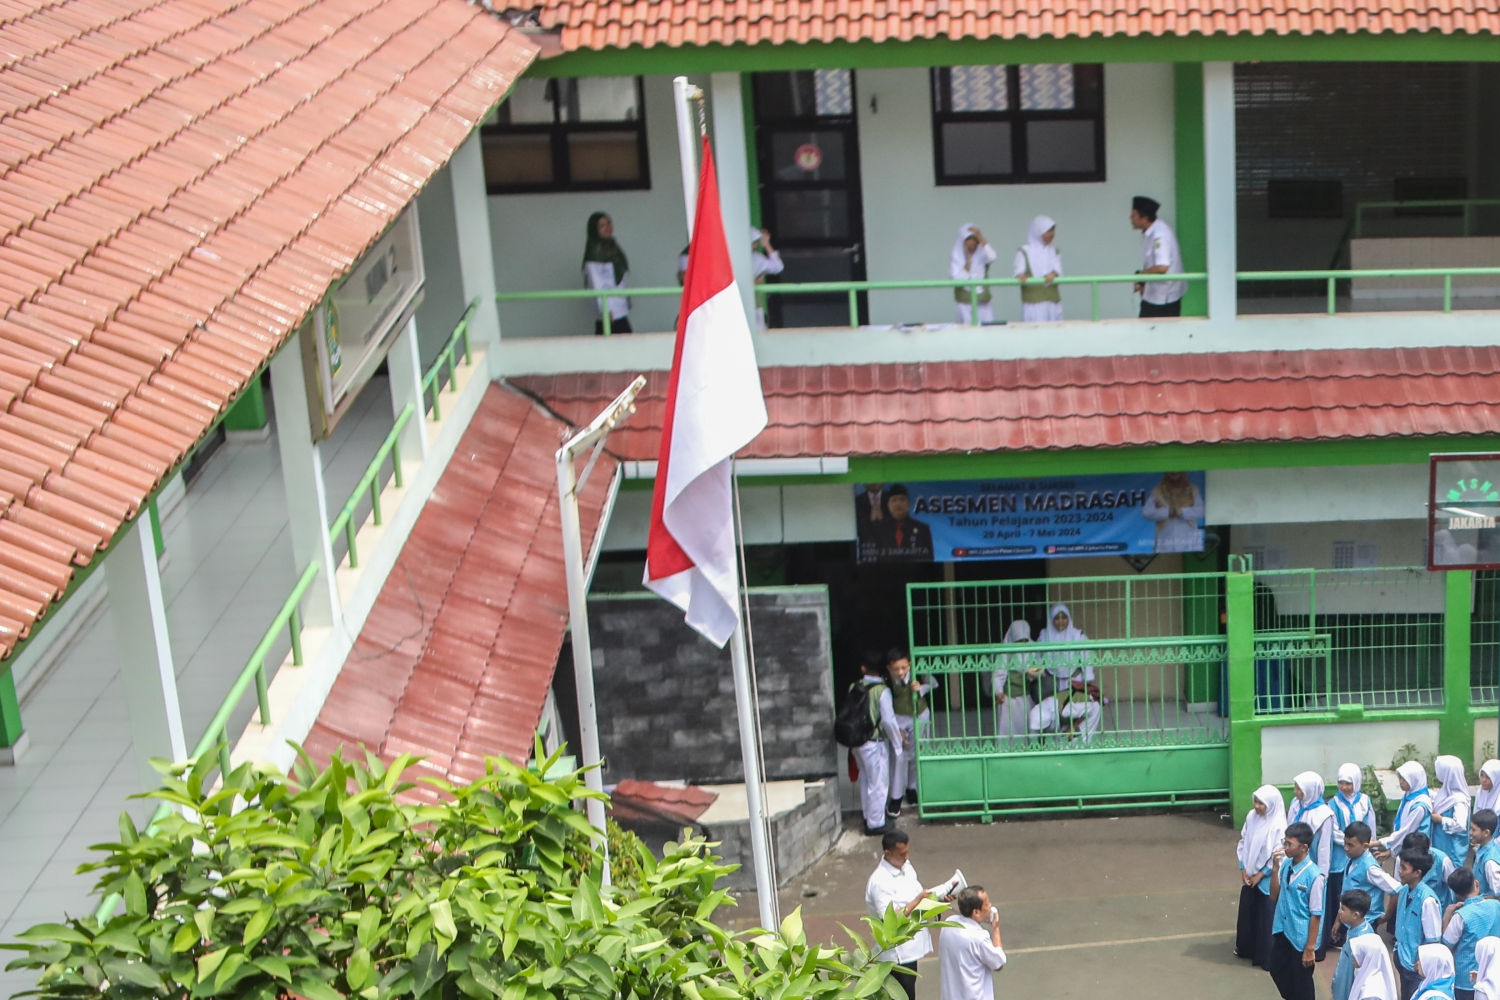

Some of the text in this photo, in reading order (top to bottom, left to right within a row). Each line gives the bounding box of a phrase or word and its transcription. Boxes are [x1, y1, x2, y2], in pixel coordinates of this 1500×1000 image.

[912, 489, 1147, 515] ASESMEN MADRASAH
[948, 512, 1114, 527] Tahun Pelajaran 2023-2024
[1448, 516, 1496, 530] JAKARTA
[997, 529, 1021, 540] April
[1058, 527, 1081, 537] 2024
